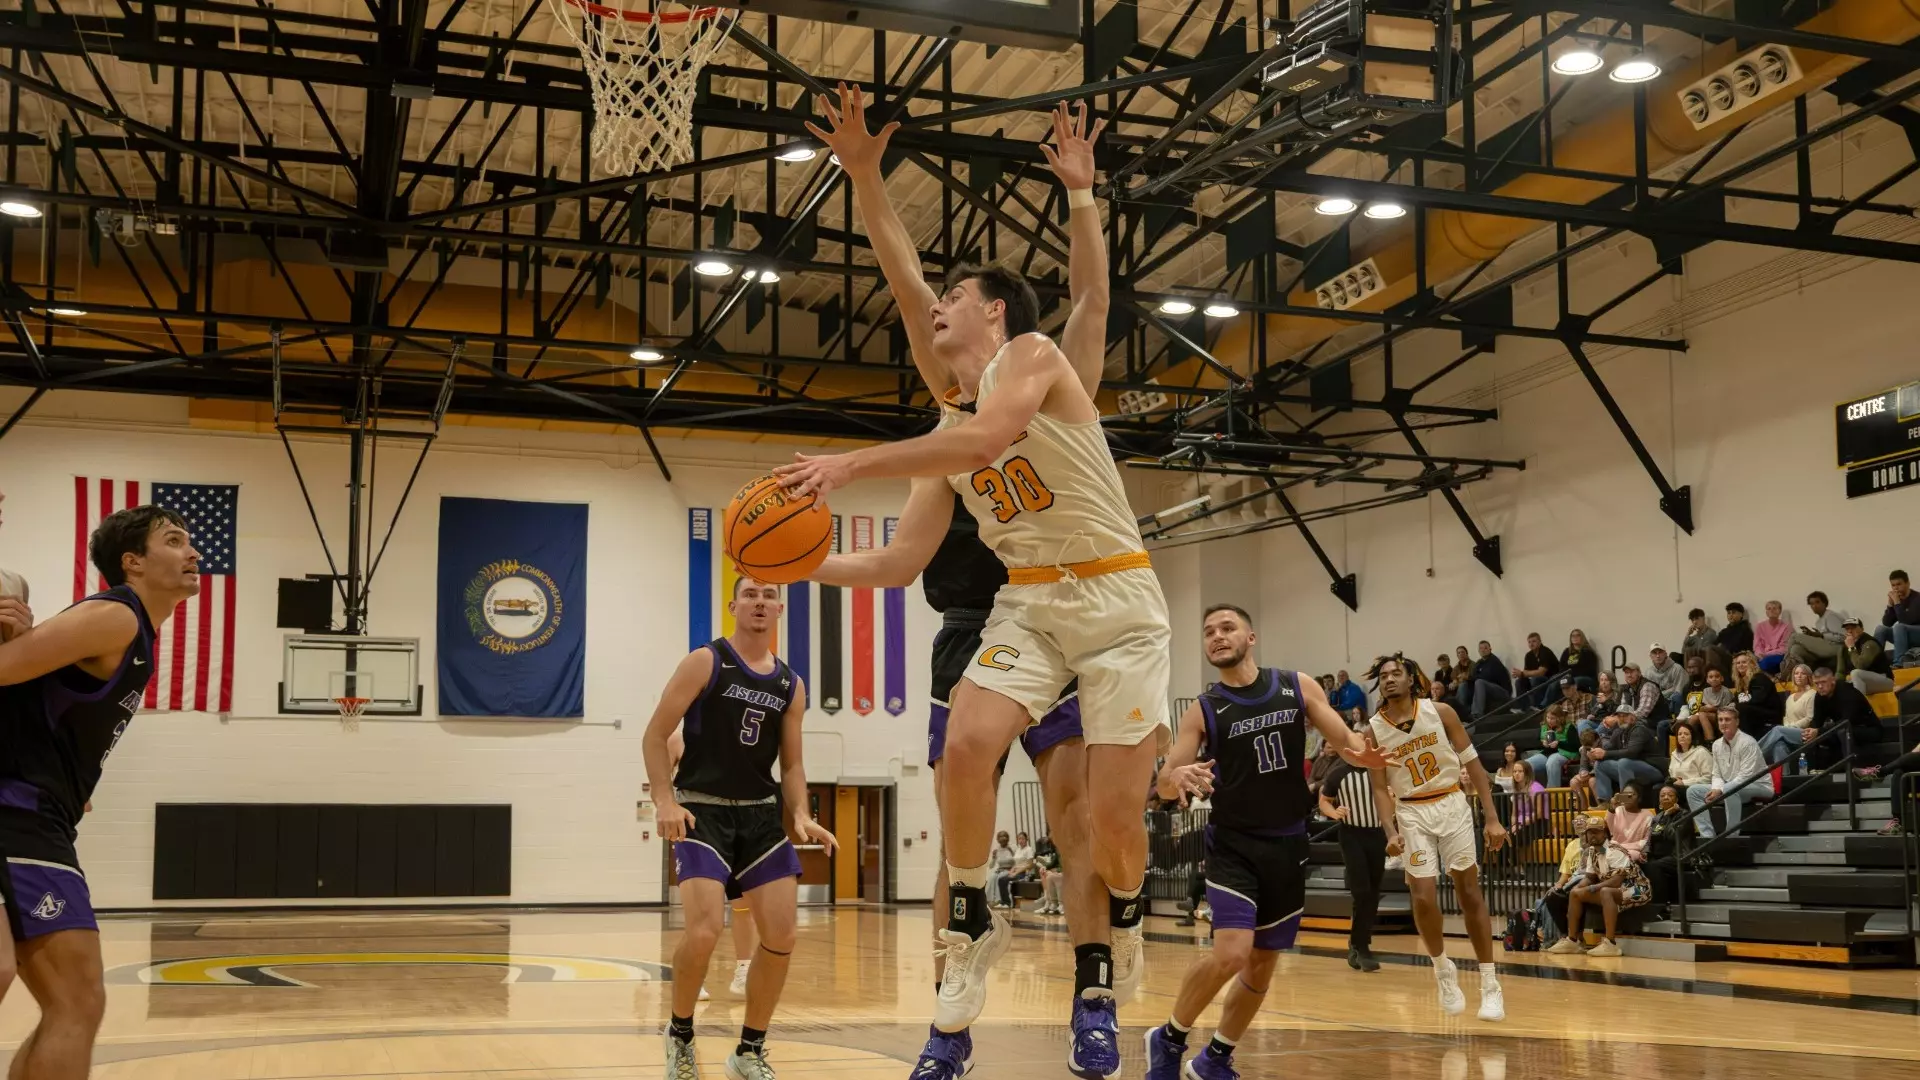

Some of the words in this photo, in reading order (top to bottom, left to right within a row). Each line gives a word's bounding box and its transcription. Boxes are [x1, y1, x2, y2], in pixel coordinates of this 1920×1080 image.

[1847, 396, 1886, 421] CENTRE
[971, 455, 1054, 523] 30
[1872, 464, 1904, 489] HOME
[692, 509, 708, 541] BERRY
[722, 683, 787, 712] ASBURY
[740, 707, 766, 746] 5
[1227, 708, 1299, 739] ASBURY
[1253, 730, 1288, 774] 11
[1391, 731, 1439, 760] CENTRE
[1404, 751, 1441, 787] 12
